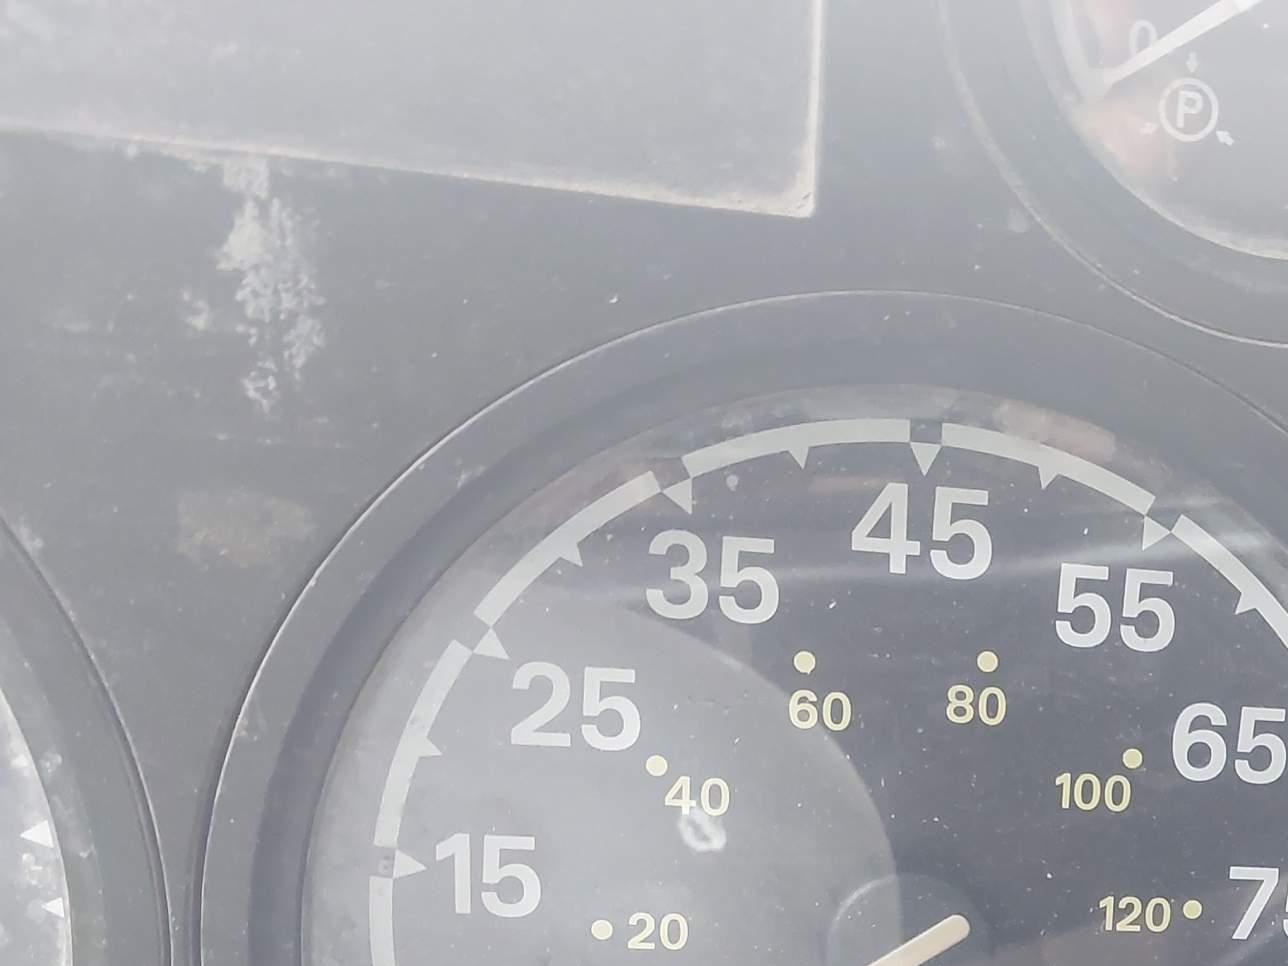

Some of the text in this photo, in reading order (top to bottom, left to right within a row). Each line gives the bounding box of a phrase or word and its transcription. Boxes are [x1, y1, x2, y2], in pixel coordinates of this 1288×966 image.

[851, 483, 993, 580] 45
[645, 530, 780, 624] 35
[1055, 563, 1176, 652] 55
[510, 662, 642, 751] 25
[788, 690, 852, 731] 60
[945, 685, 1008, 726] 80
[1172, 703, 1287, 785] 65
[664, 776, 731, 817] 40
[1055, 773, 1132, 813] 100
[435, 833, 542, 918] 15
[627, 912, 689, 951] 20
[1099, 896, 1172, 933] 120
